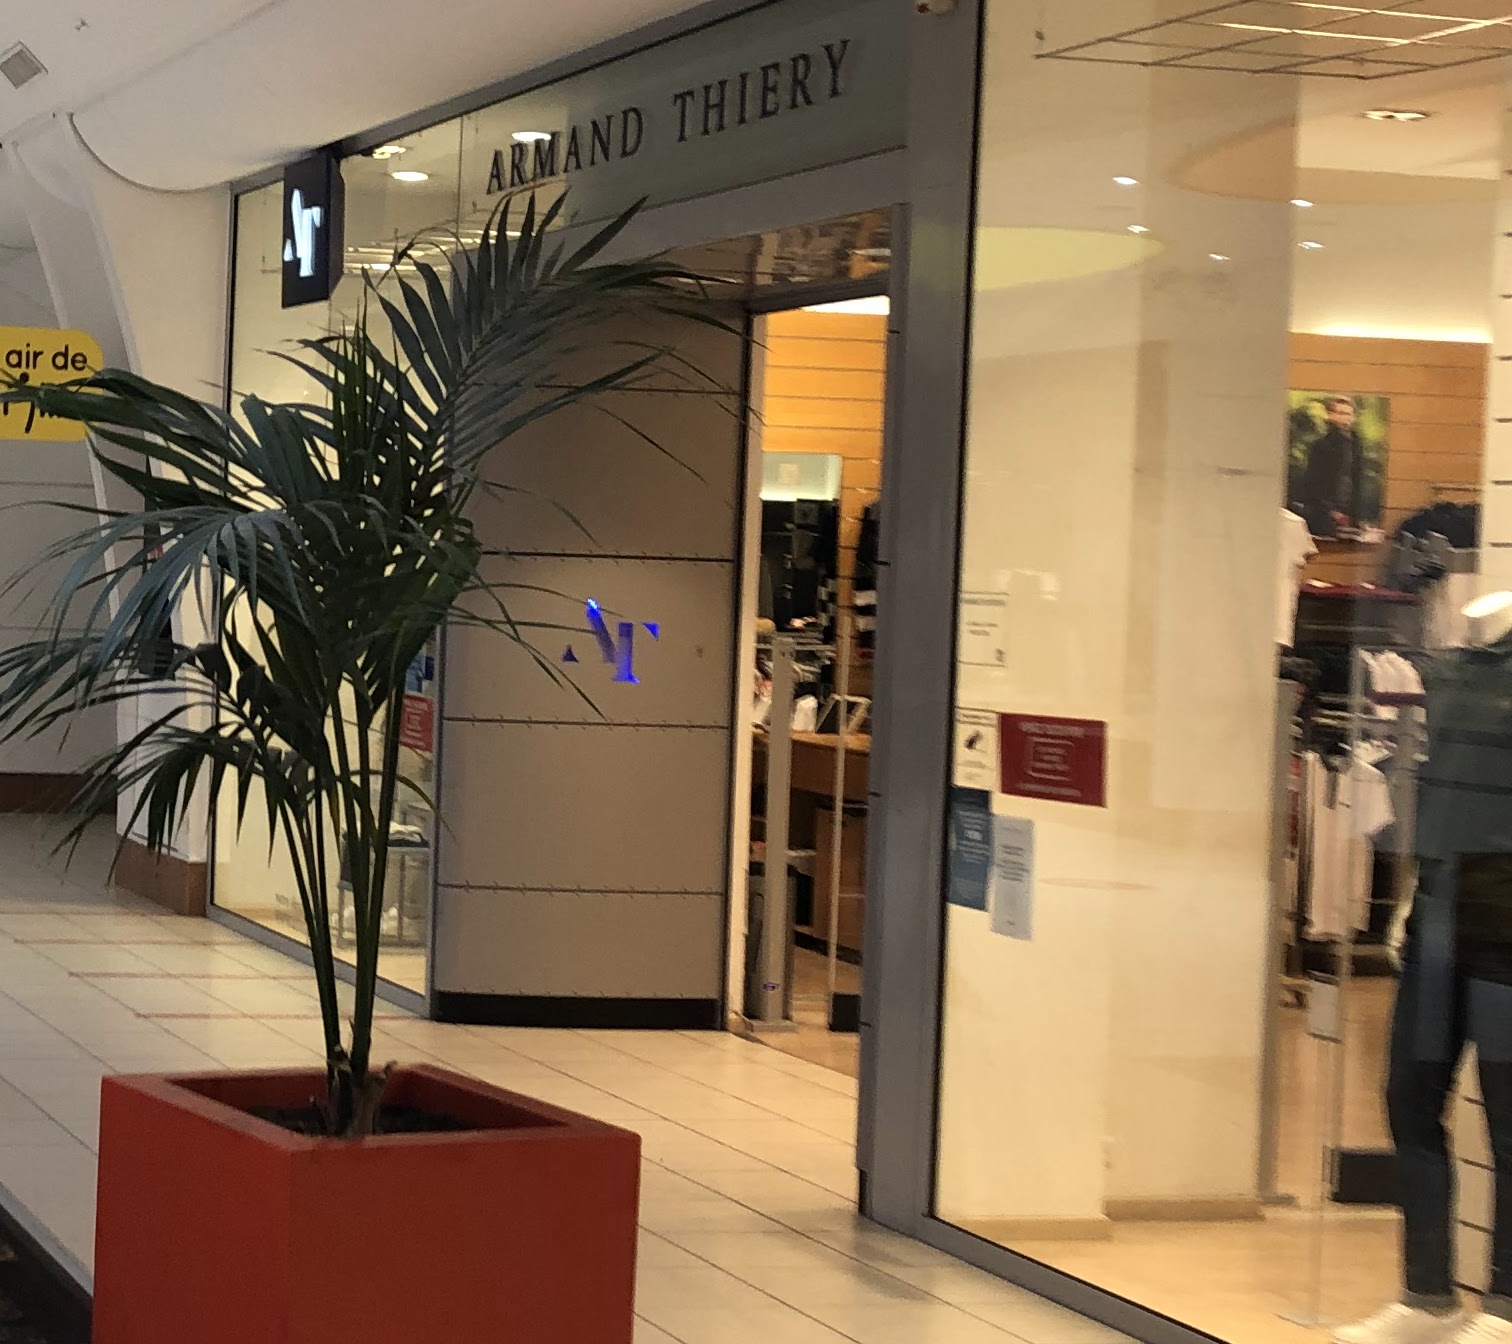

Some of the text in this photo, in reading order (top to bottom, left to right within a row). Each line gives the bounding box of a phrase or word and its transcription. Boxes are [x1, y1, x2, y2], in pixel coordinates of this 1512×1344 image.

[485, 38, 851, 196] ARMAND THIERY
[4, 342, 45, 371] air
[51, 343, 88, 372] de
